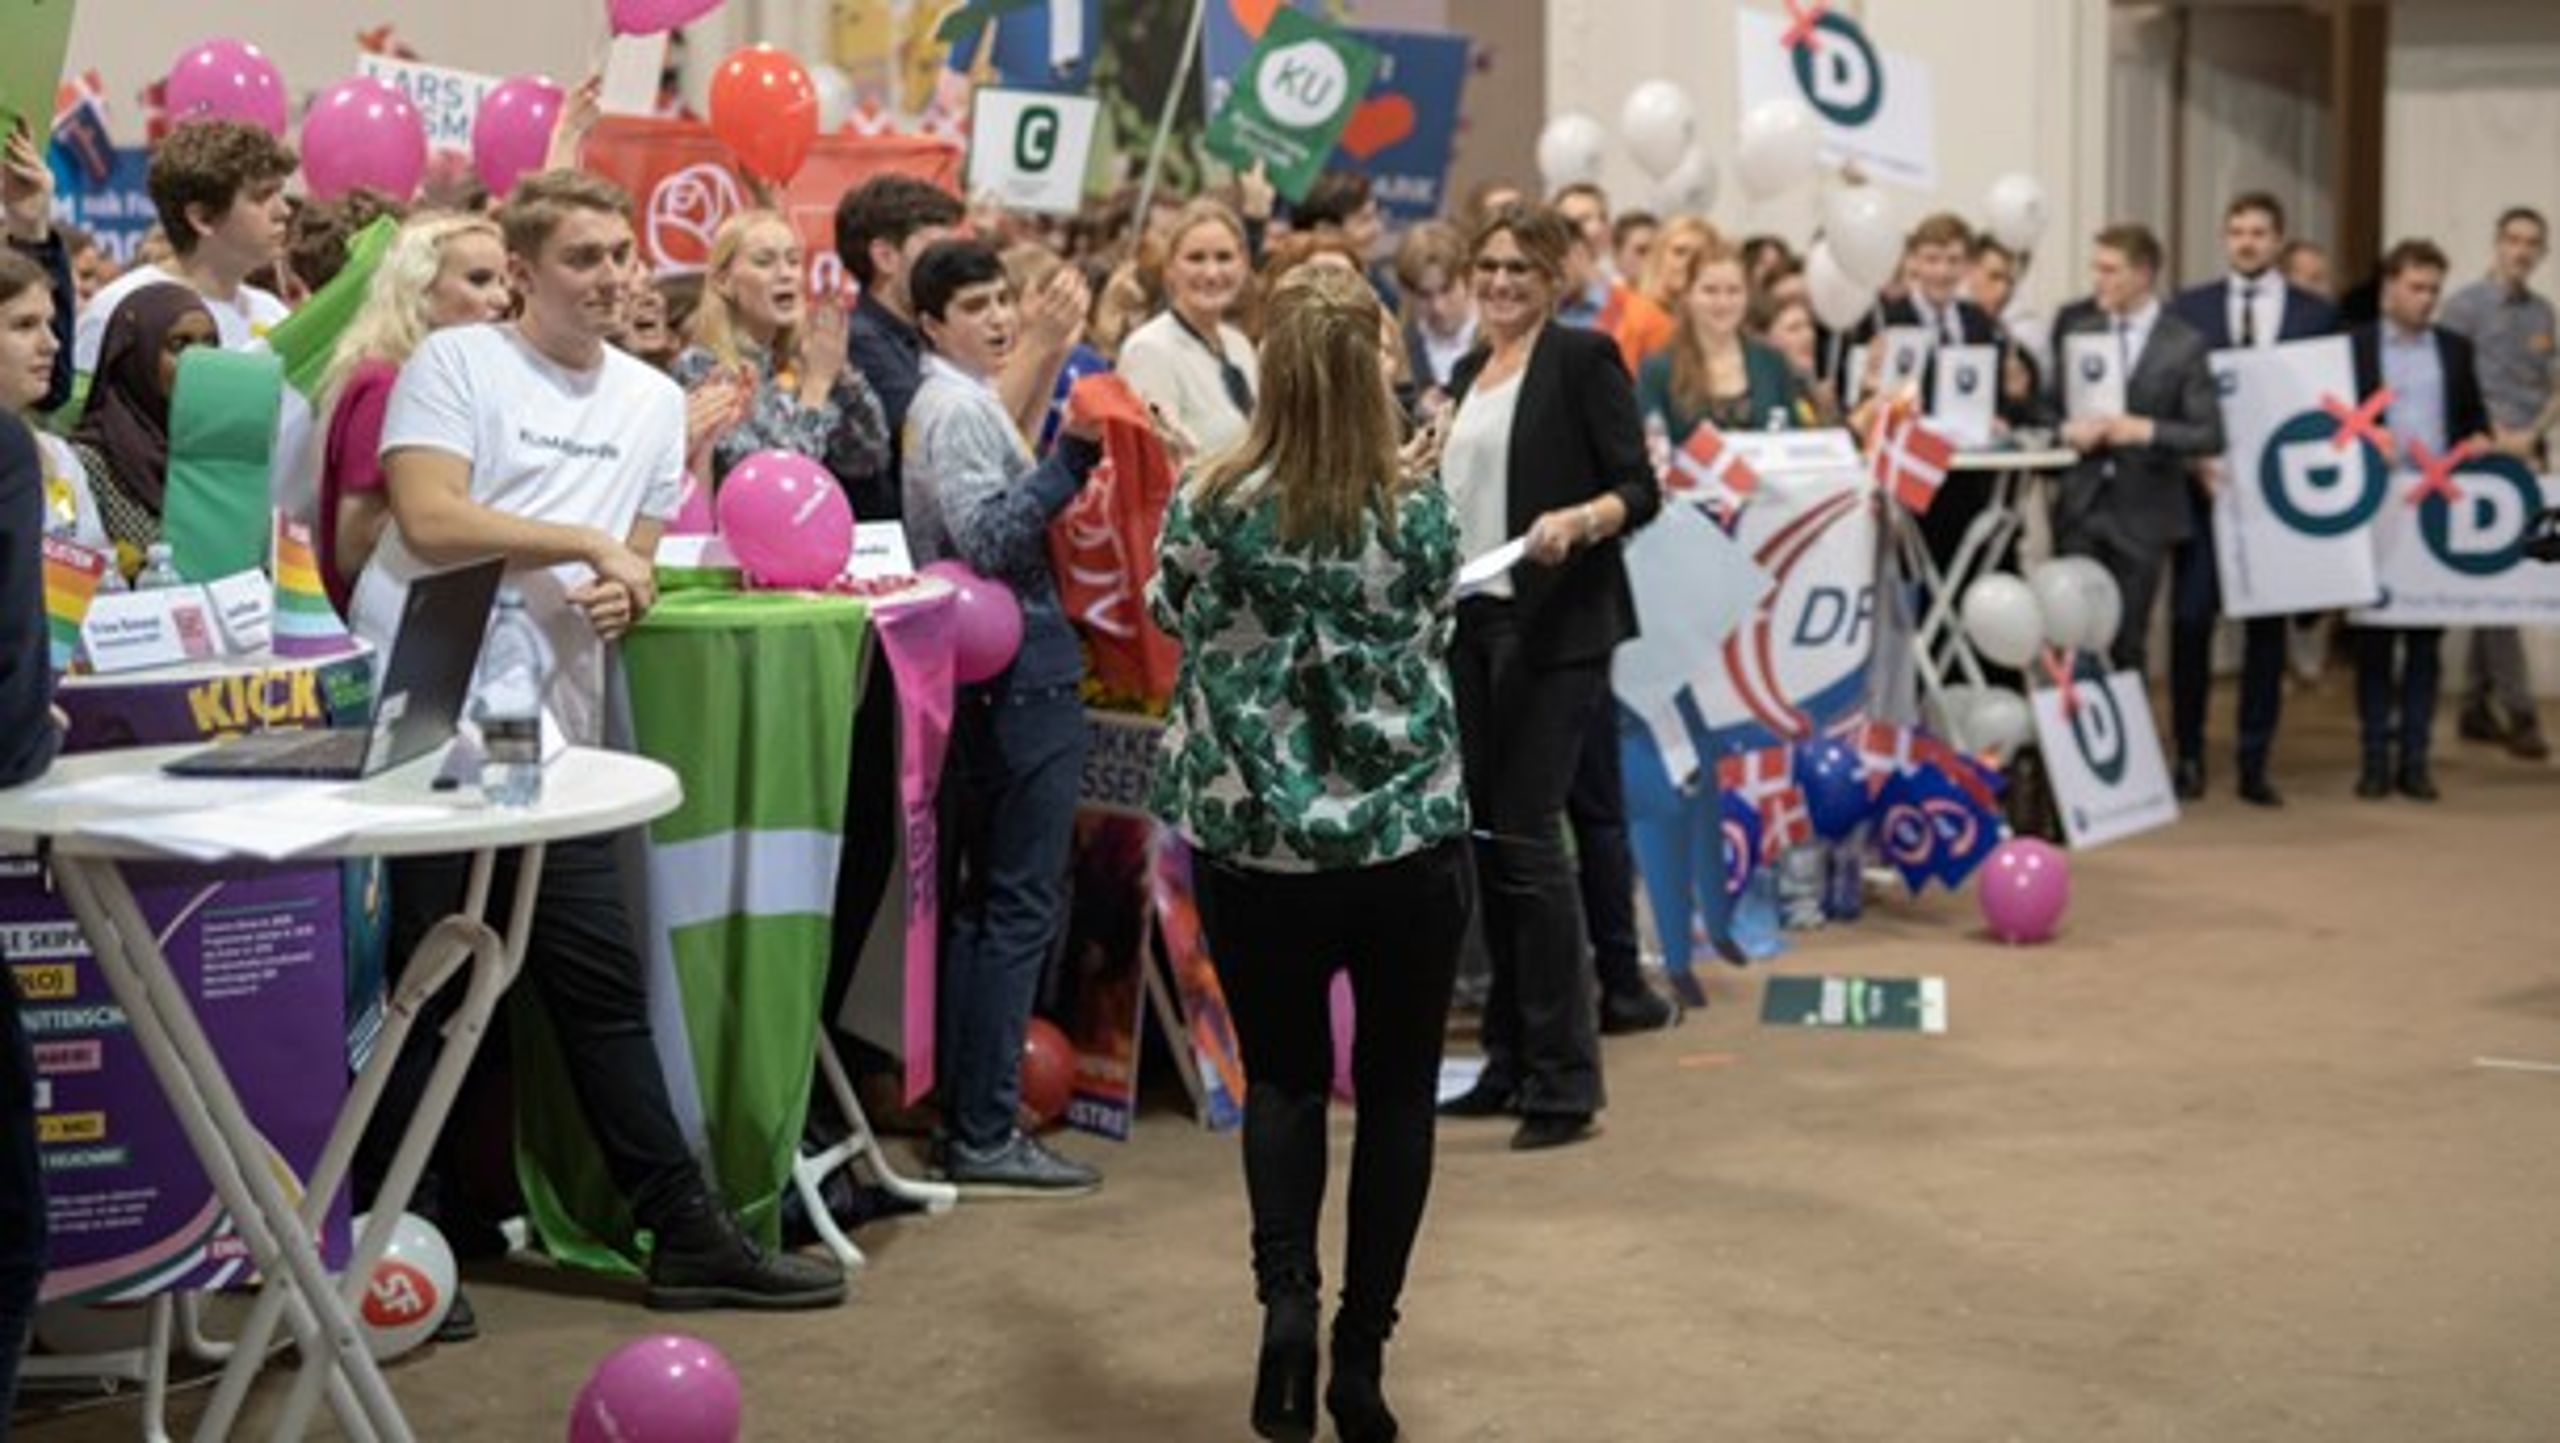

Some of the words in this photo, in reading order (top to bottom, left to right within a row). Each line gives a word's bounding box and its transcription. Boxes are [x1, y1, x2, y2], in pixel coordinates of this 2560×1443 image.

[1273, 56, 1338, 109] KU
[2278, 437, 2367, 519] D
[2448, 471, 2526, 555] D
[371, 1272, 423, 1314] SF
